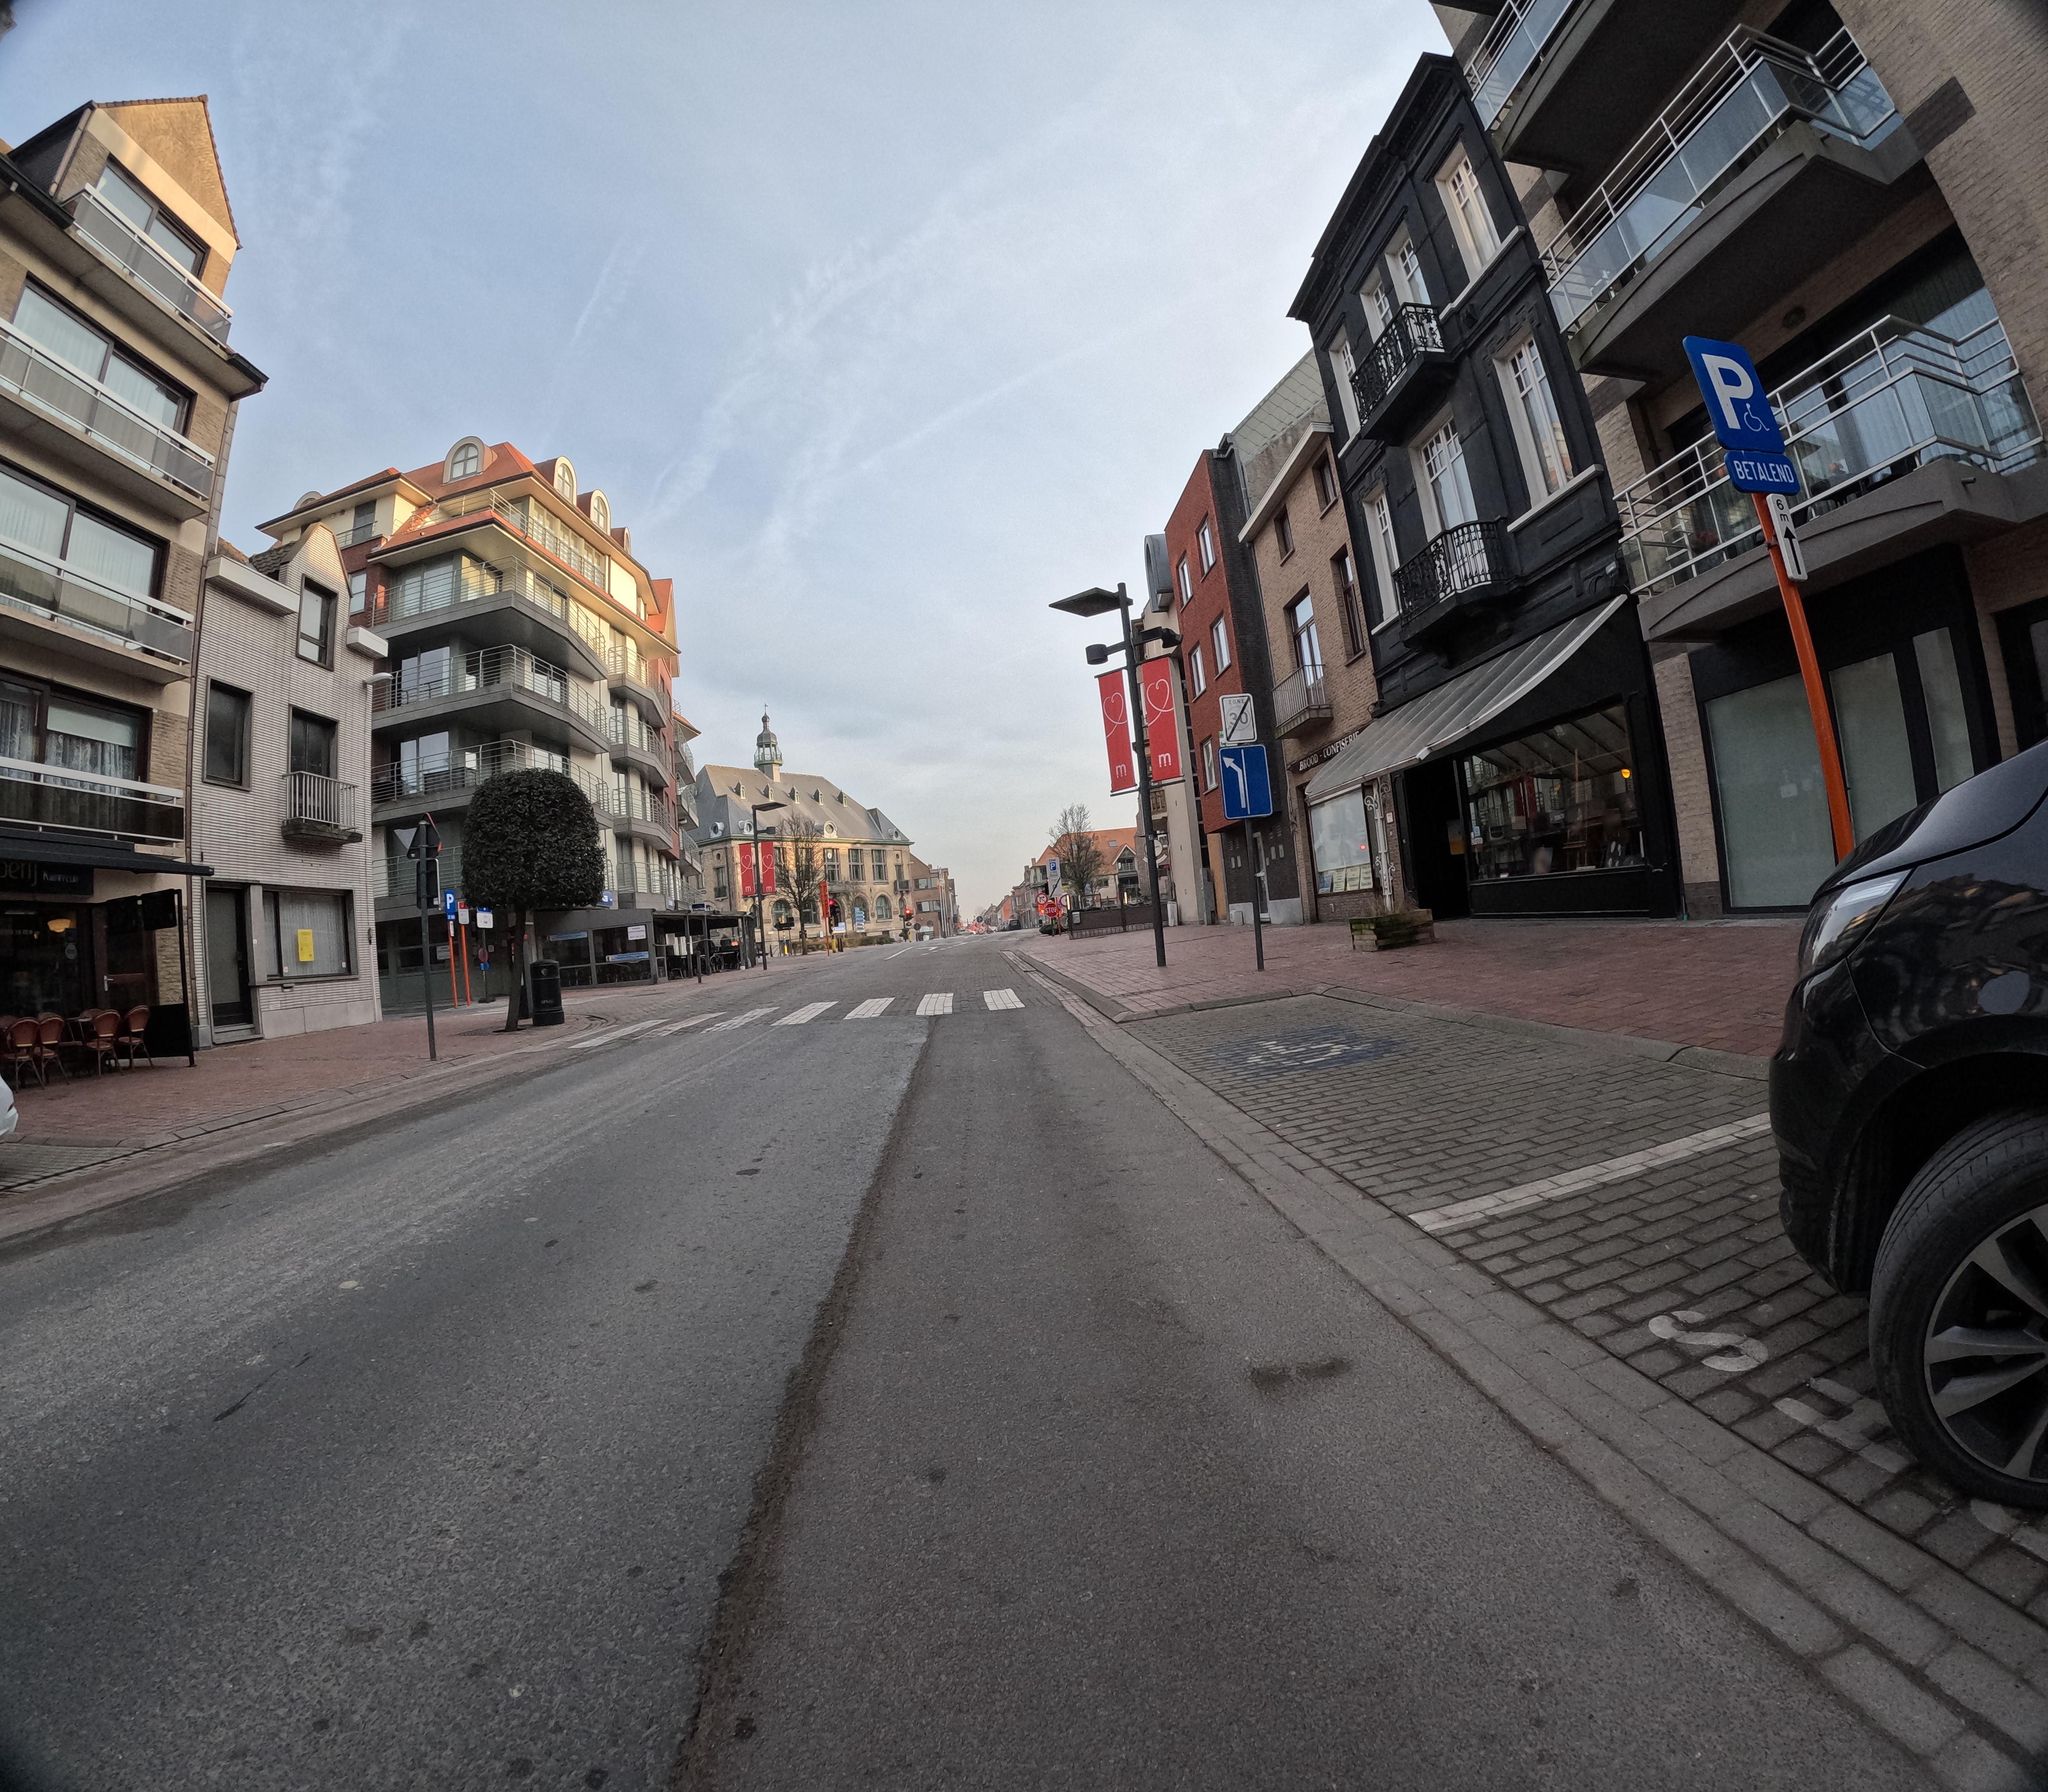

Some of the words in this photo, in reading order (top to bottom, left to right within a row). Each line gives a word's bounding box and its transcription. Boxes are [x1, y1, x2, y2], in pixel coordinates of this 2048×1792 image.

[1701, 353, 1754, 430] P
[1733, 460, 1795, 484] BETALEND
[1776, 499, 1785, 511] 6
[1779, 513, 1790, 523] m
[1229, 712, 1249, 726] 30
[1299, 753, 1319, 771] BROOD
[446, 893, 454, 910] P
